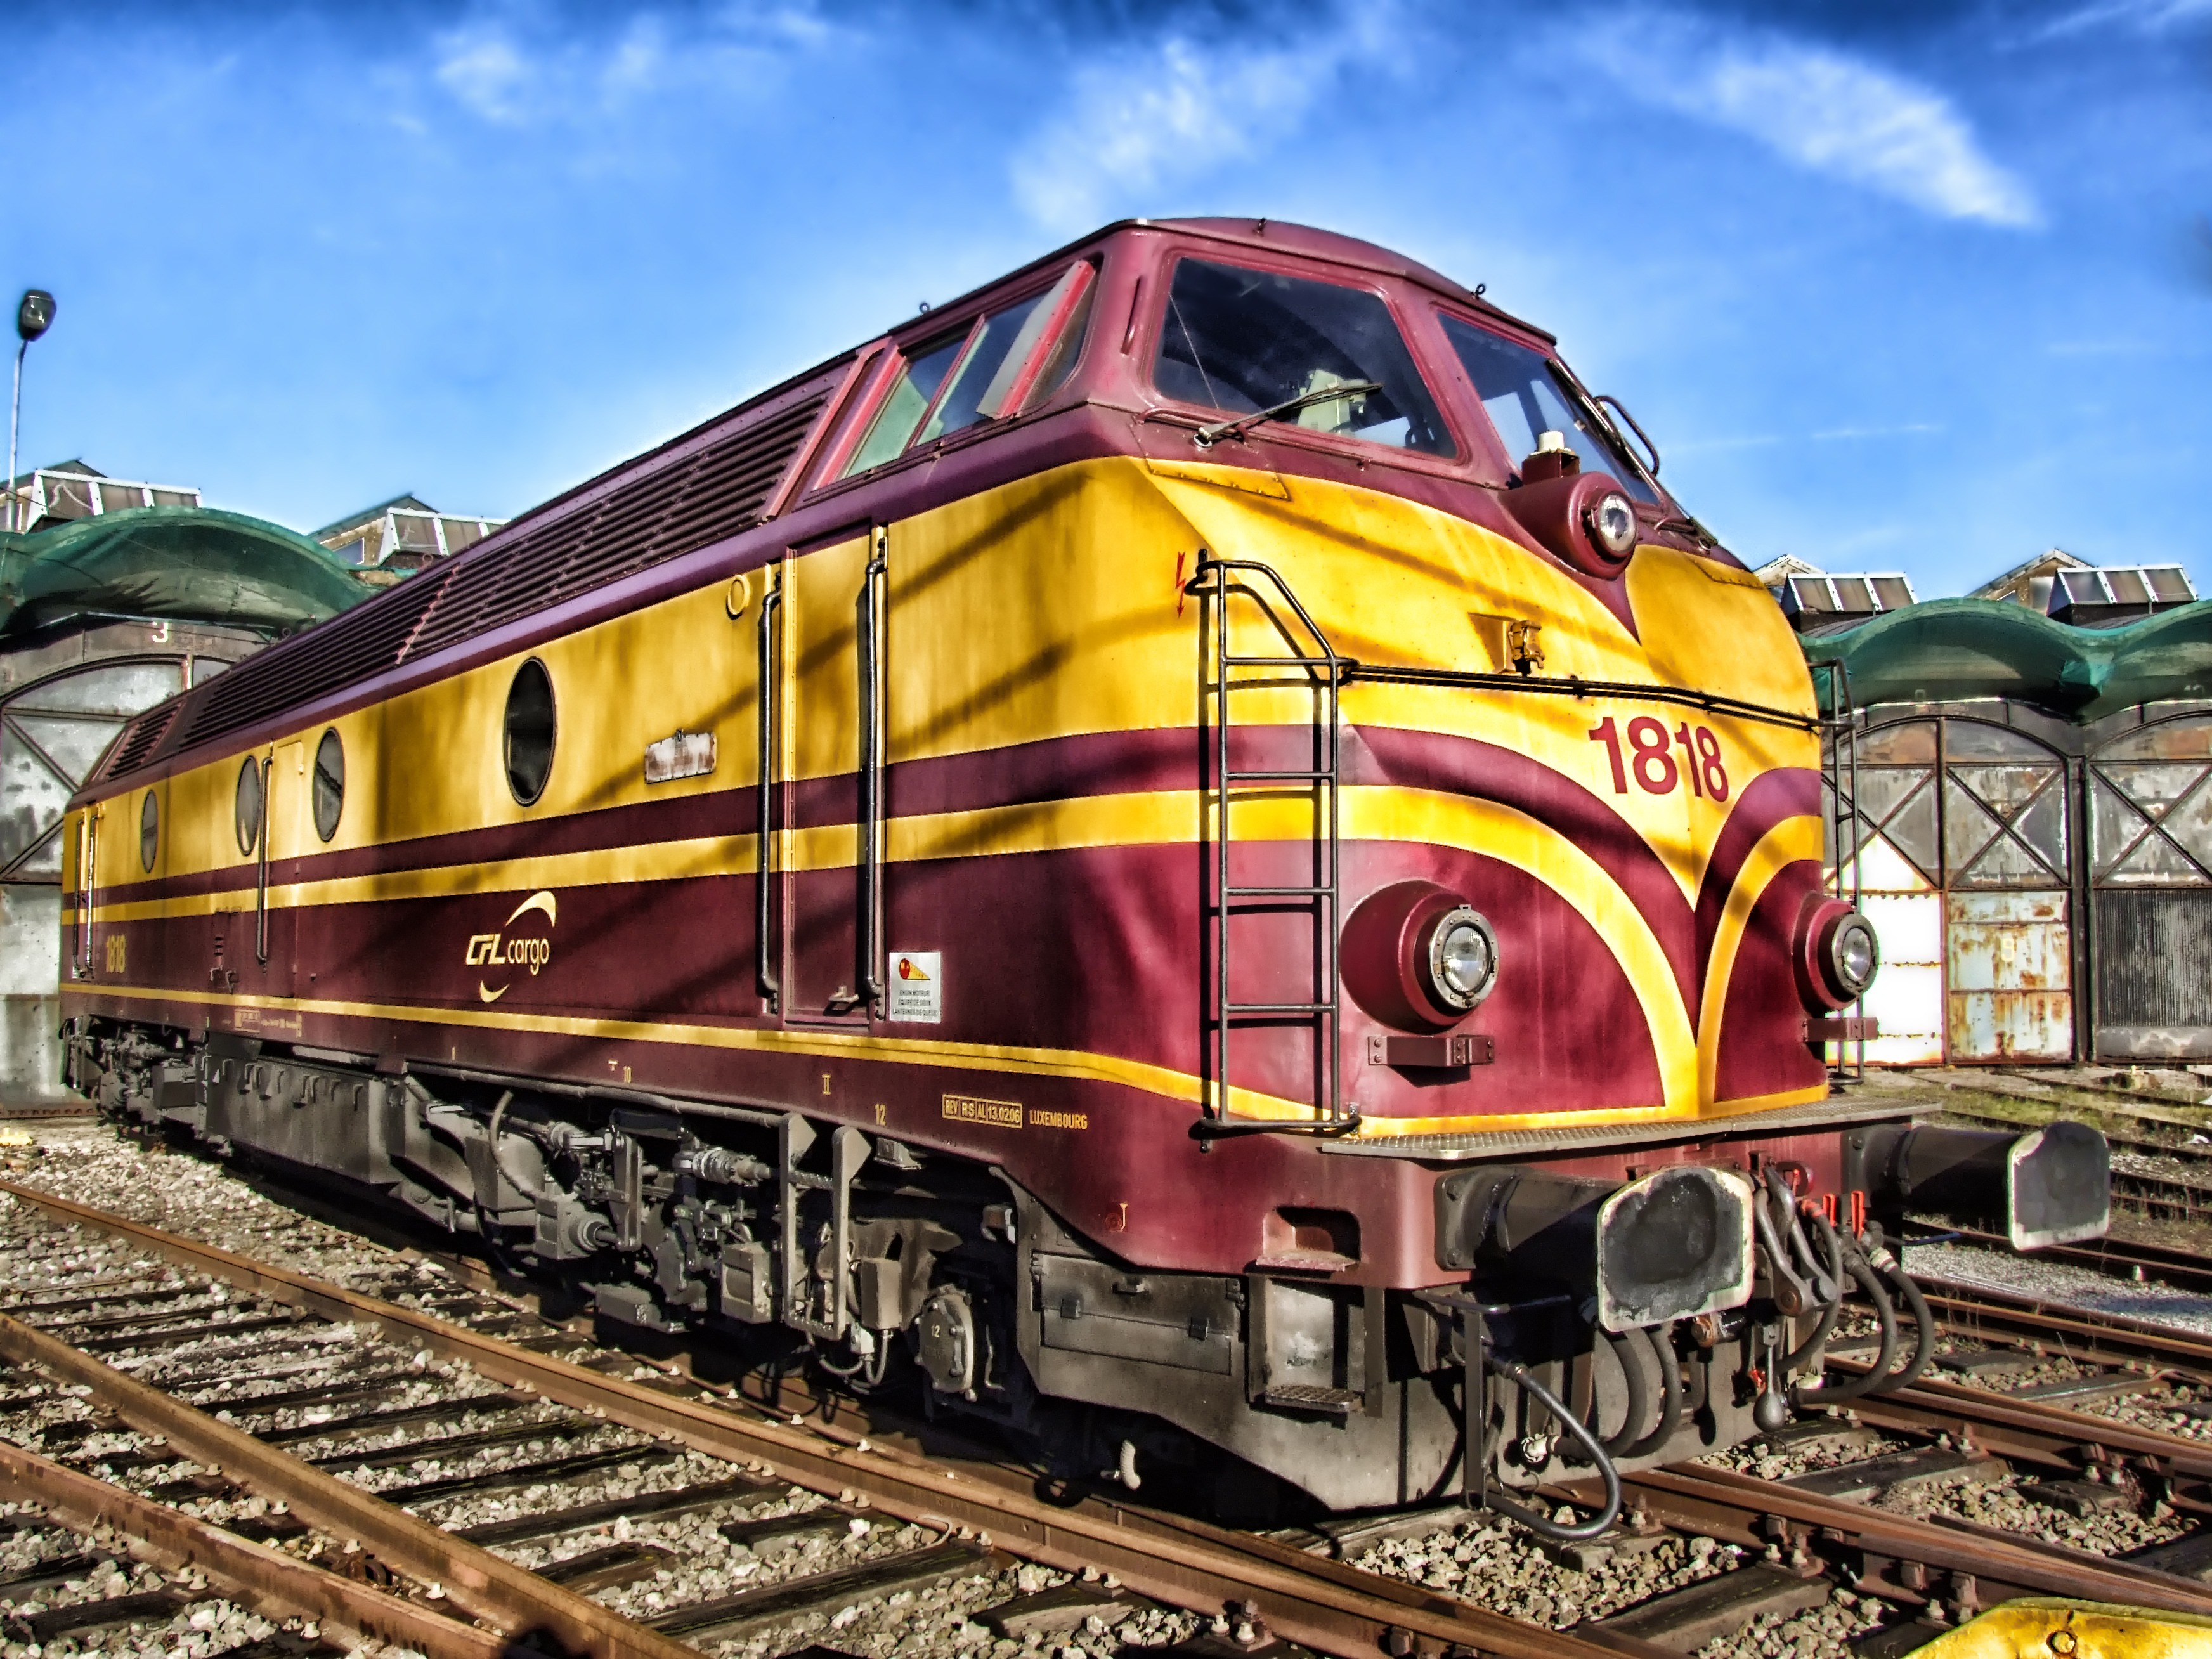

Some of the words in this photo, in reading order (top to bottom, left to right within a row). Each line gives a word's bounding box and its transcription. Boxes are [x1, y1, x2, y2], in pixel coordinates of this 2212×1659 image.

[152, 622, 168, 643] 3
[1587, 716, 1729, 802] 1818
[106, 934, 126, 973] 1818
[465, 934, 506, 965] CFL
[507, 938, 550, 975] cargo
[875, 1103, 886, 1126] 12
[945, 1100, 958, 1114] REV
[977, 1104, 986, 1119] AL
[1029, 1110, 1088, 1130] LUXEMBOURG
